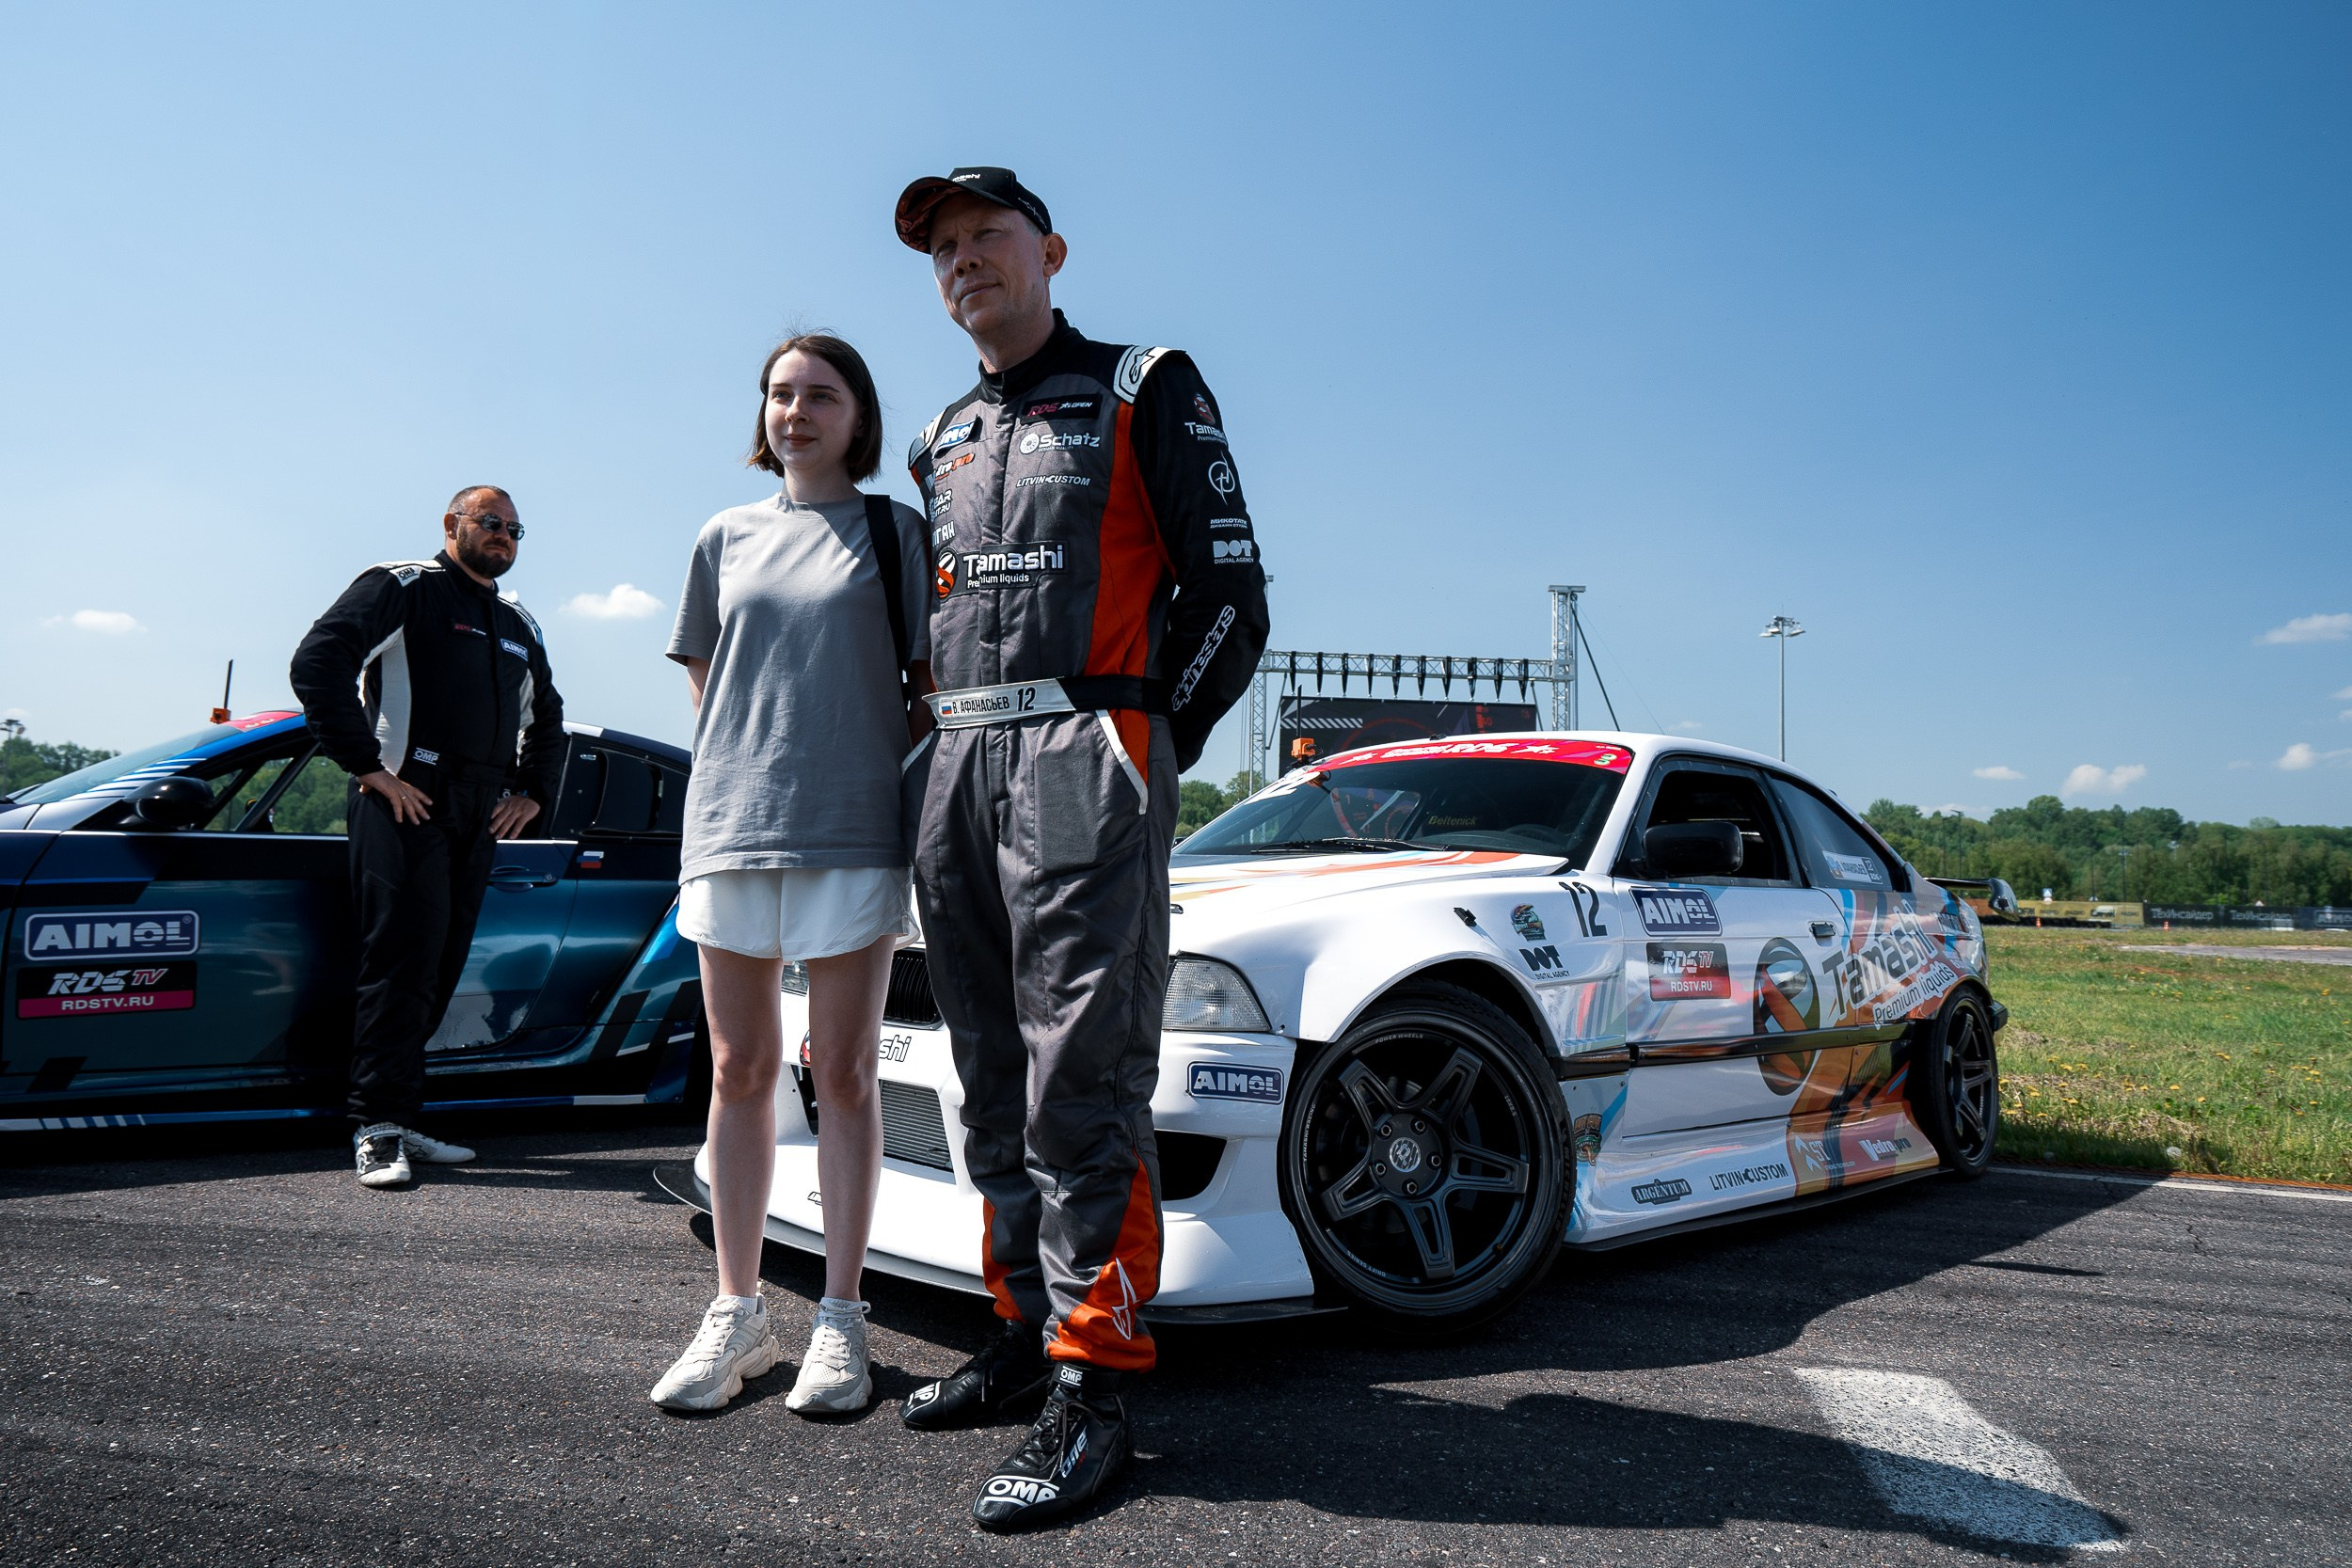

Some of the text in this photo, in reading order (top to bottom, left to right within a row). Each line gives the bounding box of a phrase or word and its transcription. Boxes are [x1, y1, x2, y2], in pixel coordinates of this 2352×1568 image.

[1039, 433, 1100, 448] Schatz
[963, 545, 1063, 578] Tamashi
[1000, 573, 1029, 586] liquids
[961, 696, 1009, 714] АФАНАСЬЕВ
[1017, 687, 1036, 712] 12
[414, 749, 439, 763] OMP
[1558, 881, 1608, 938] 12
[1641, 897, 1717, 925] AIMOL
[32, 921, 191, 951] AIMOL
[1822, 901, 1937, 1016] Tamashi
[1671, 980, 1712, 992] RDSTV.RU
[61, 995, 154, 1011] RDSTV.RU
[1193, 1070, 1279, 1097] AIMOL
[1635, 1181, 1690, 1202] ARGENTUM
[1060, 1368, 1083, 1384] OMP
